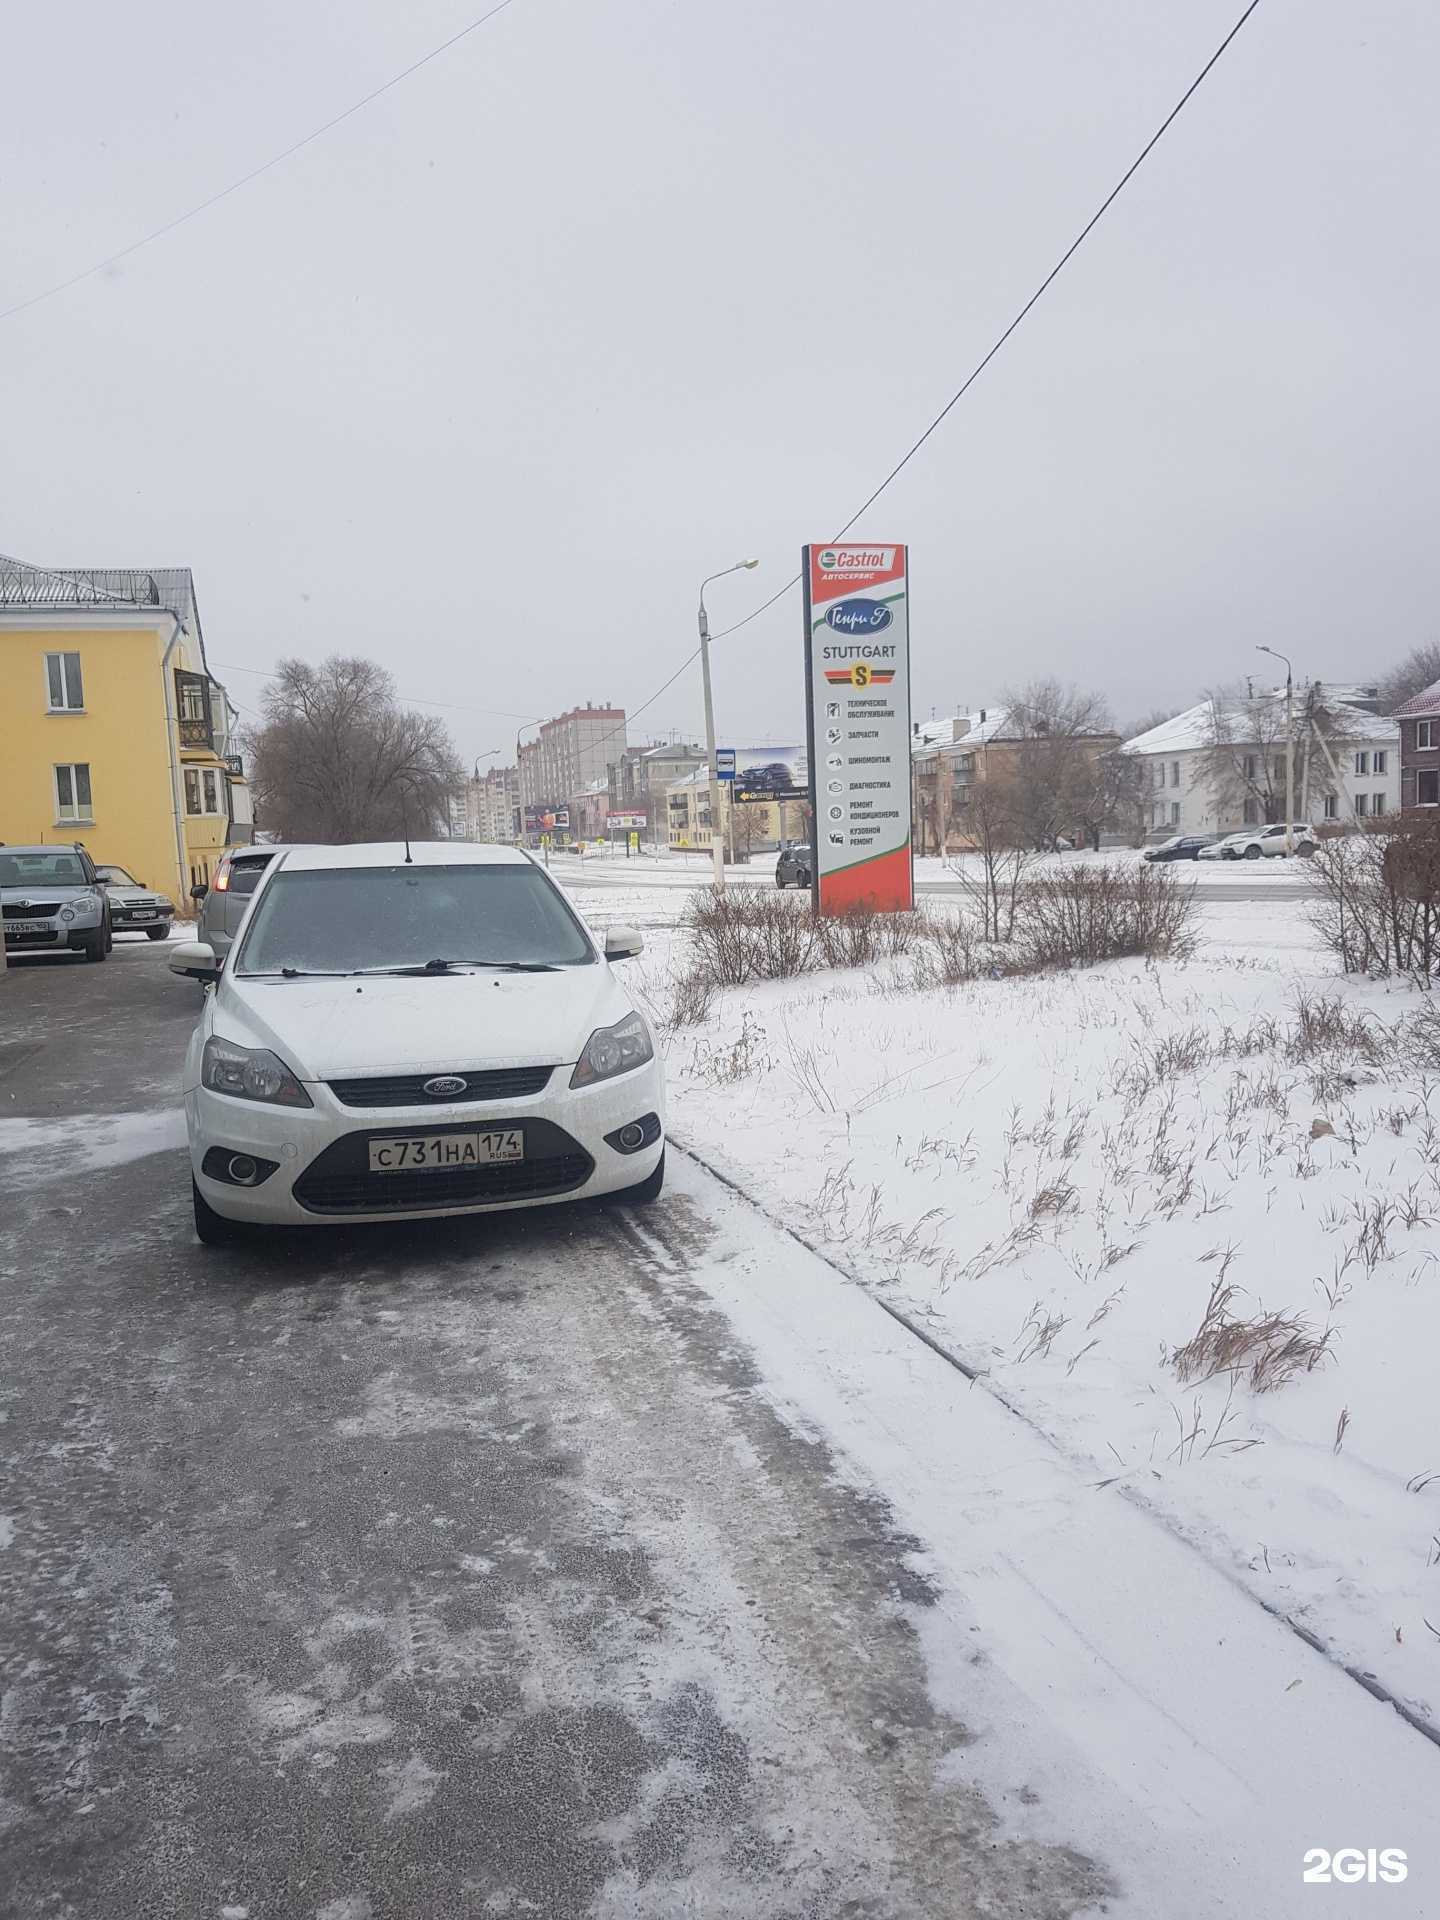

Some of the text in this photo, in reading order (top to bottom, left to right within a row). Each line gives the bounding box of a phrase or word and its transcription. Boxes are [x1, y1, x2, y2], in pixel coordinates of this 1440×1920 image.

[837, 551, 884, 567] Castrol
[821, 572, 875, 581] АВТОСЕРВИС
[823, 646, 896, 659] STUTTGART
[855, 665, 867, 686] S
[848, 731, 879, 739] ЗАПЧАСТИ
[848, 756, 891, 765] ШИНОМОНТАЖ
[849, 781, 891, 790] ДИАГНОСТИКА
[849, 801, 873, 809] РЕМОНТ
[849, 826, 880, 835] КУЗОВНОЙ
[849, 838, 873, 846] РЕМОНТ
[378, 1132, 518, 1167] С731НА 174
[489, 1151, 508, 1160] RUS
